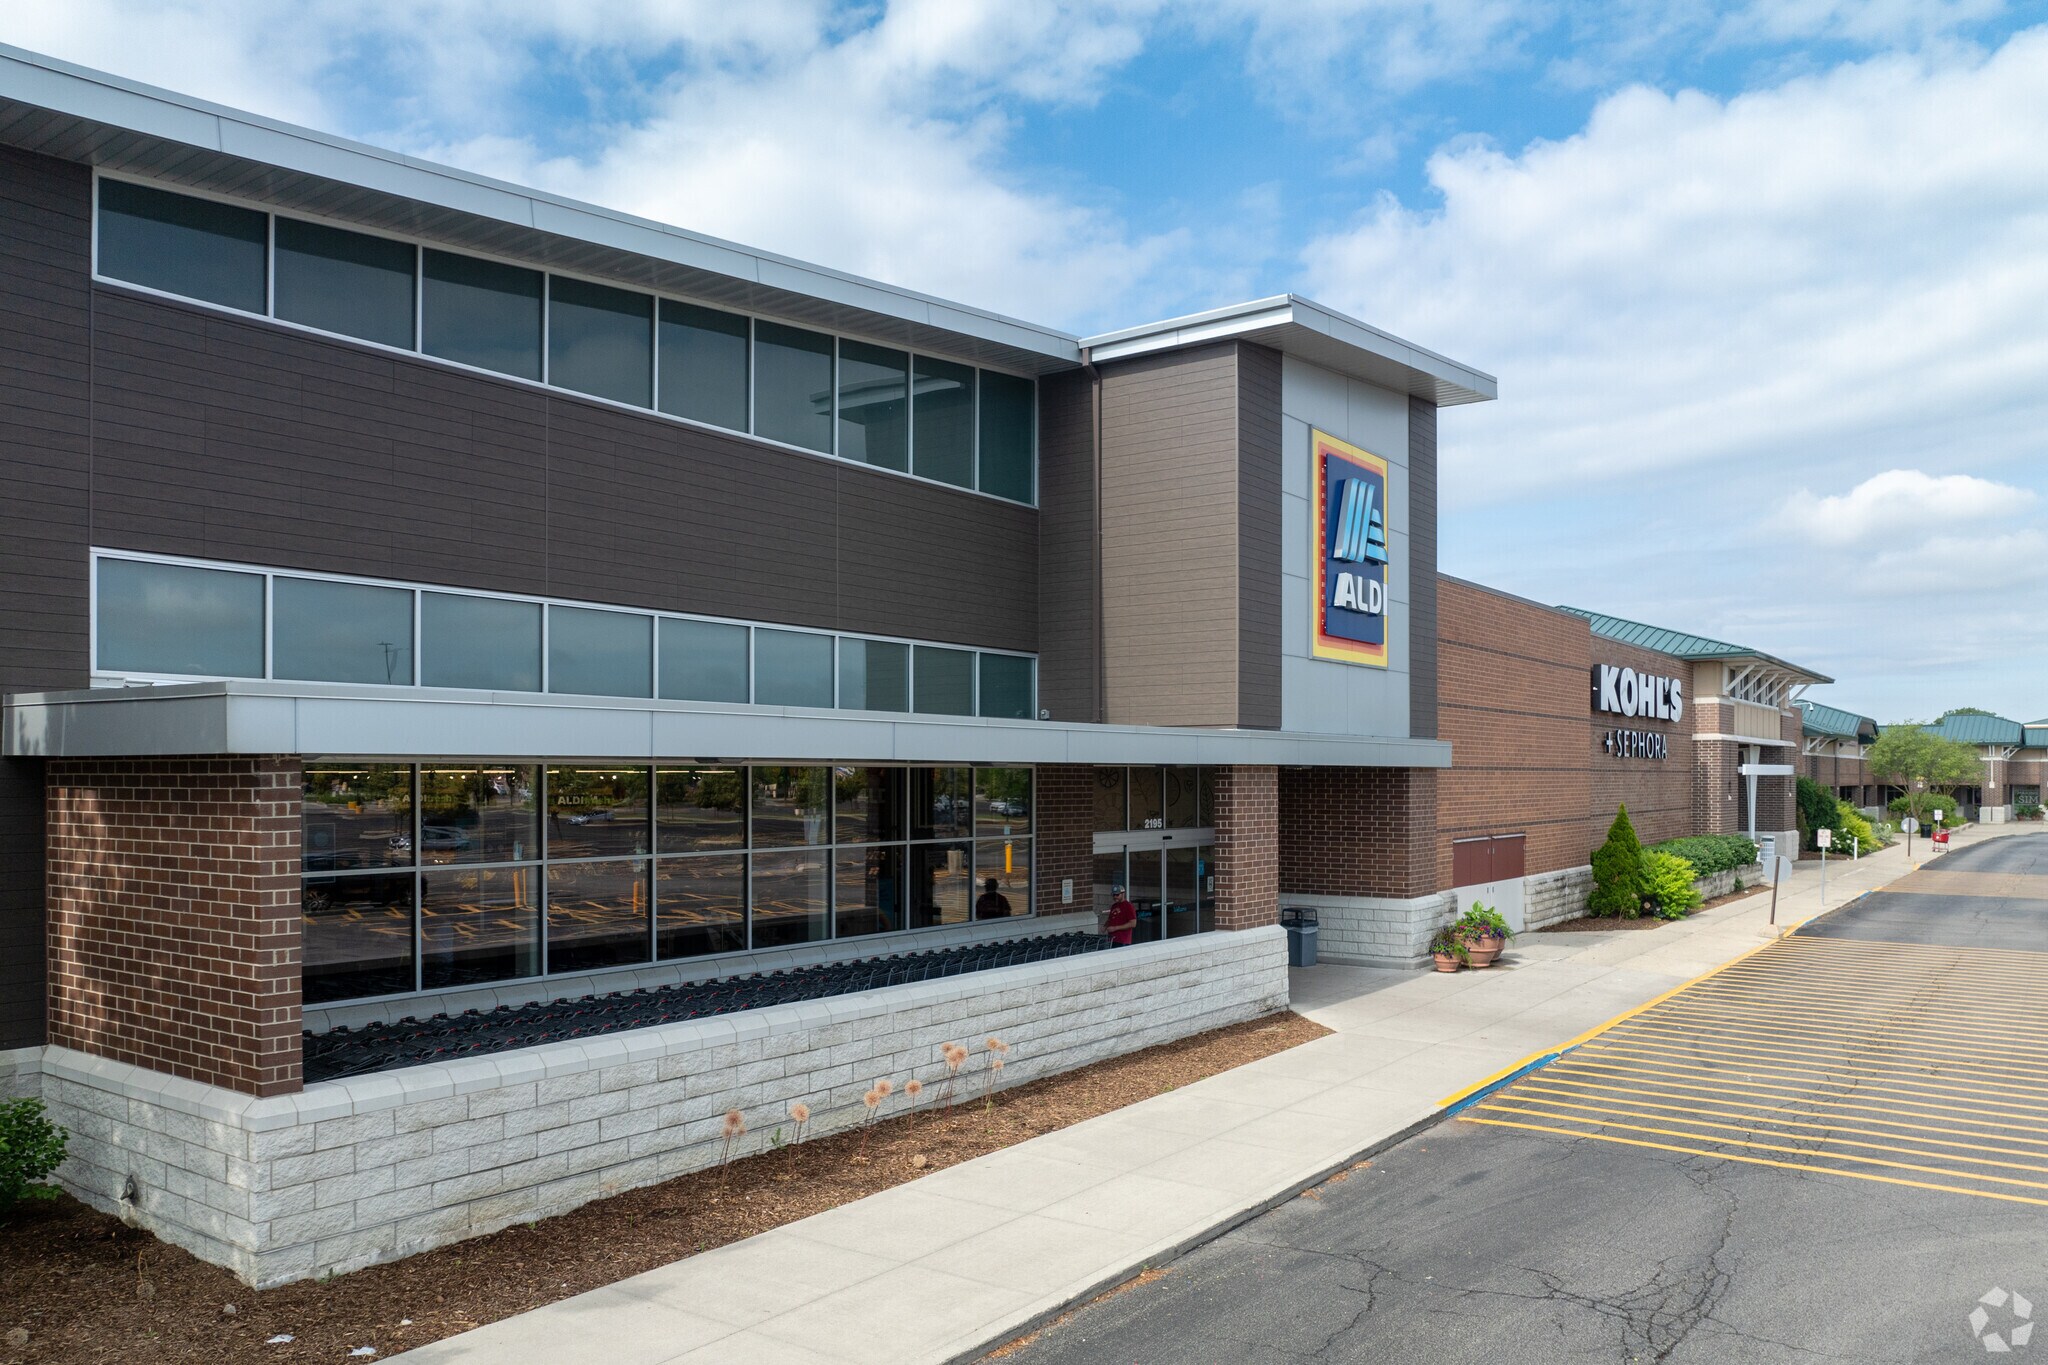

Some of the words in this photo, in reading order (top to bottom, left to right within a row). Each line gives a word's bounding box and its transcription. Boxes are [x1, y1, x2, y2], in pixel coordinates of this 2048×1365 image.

[1335, 572, 1388, 616] ALDI
[1599, 664, 1683, 722] KOHL'S
[1617, 729, 1668, 759] SEPHORA
[1144, 818, 1163, 829] 2195
